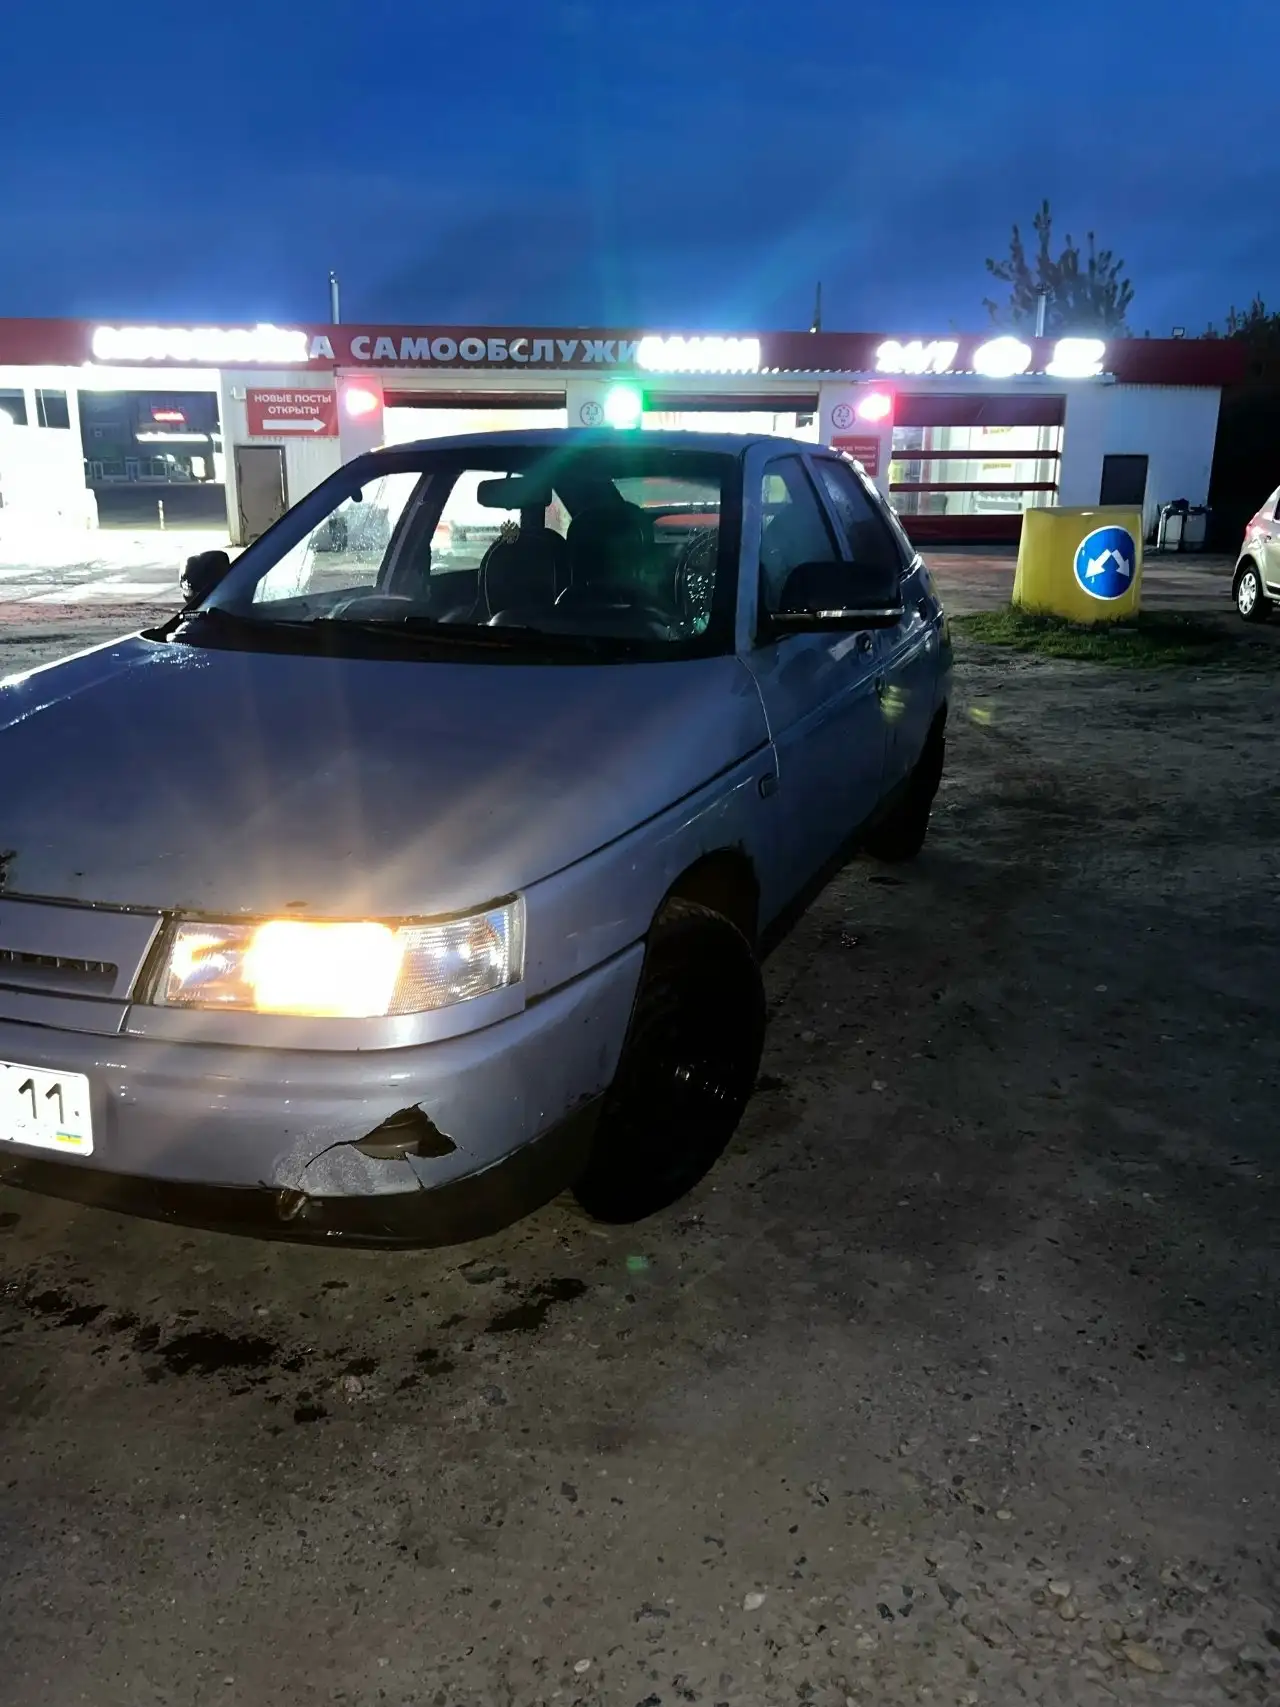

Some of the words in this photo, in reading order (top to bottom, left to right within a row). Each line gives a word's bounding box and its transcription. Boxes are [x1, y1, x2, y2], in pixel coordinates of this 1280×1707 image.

[254, 394, 293, 403] НОВЫЕ
[294, 394, 332, 403] ПОСТЫ
[268, 406, 320, 415] ОТКРЫТЫ
